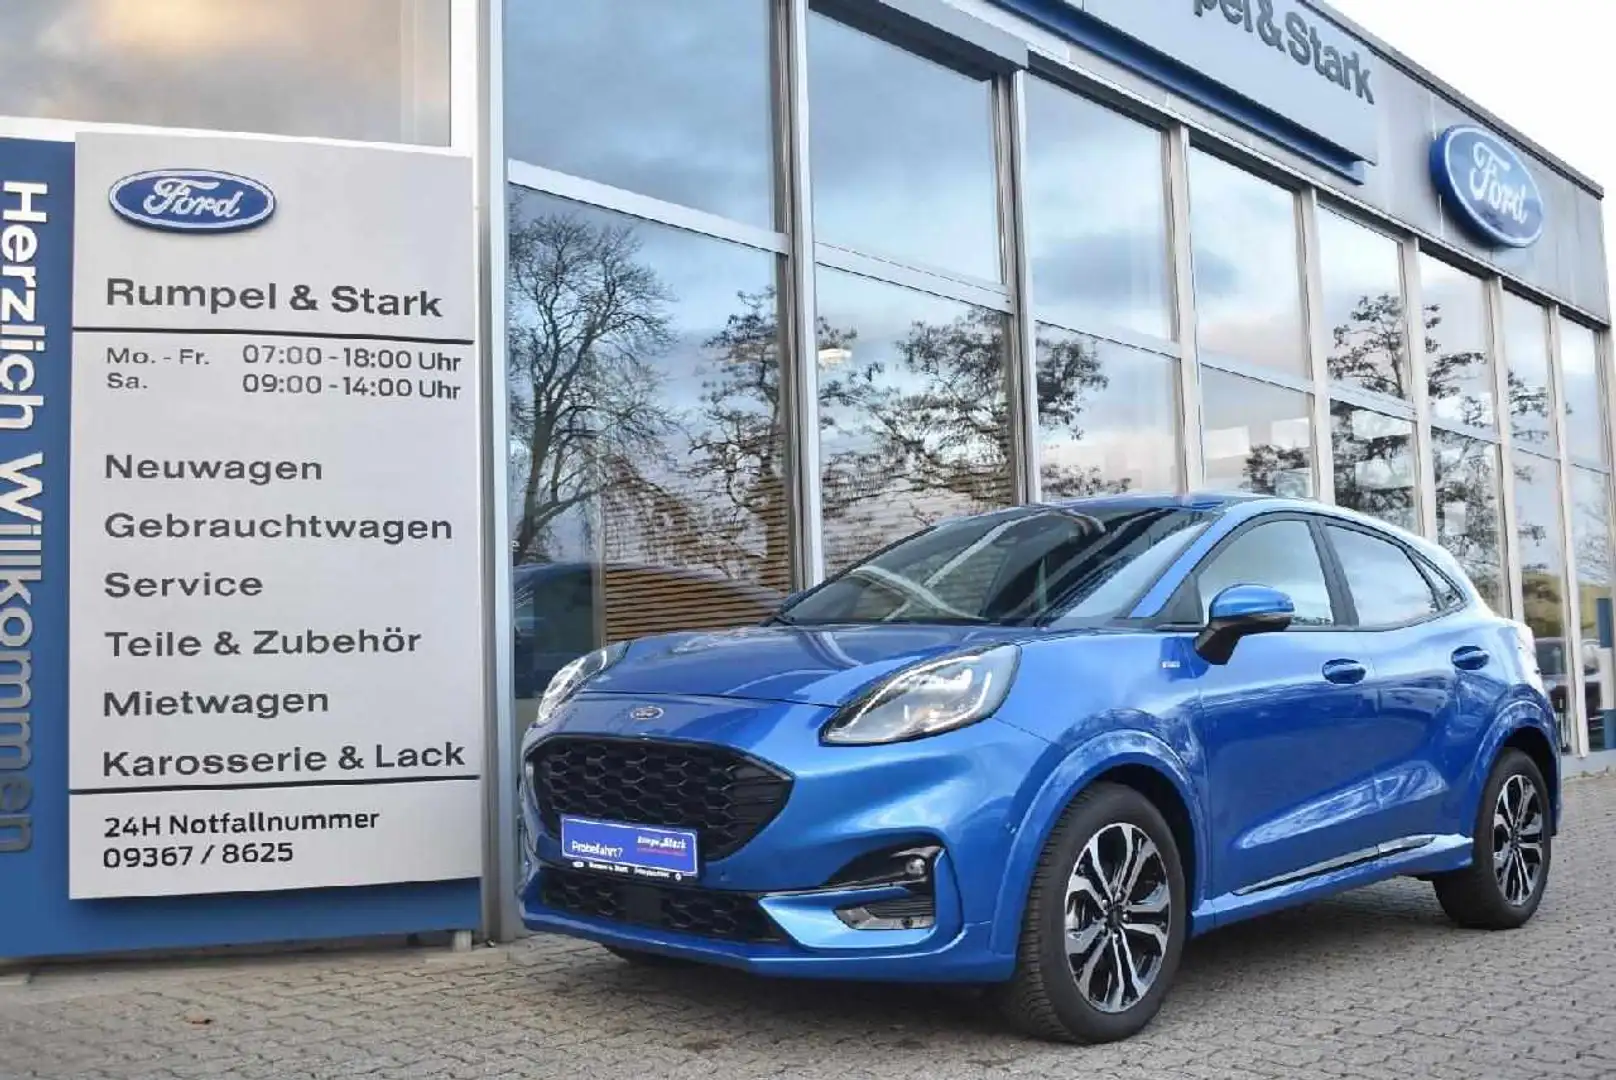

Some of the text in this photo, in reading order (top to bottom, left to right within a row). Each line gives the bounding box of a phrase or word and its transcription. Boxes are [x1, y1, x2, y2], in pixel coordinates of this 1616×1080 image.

[143, 177, 243, 218] Ford
[1469, 141, 1529, 224] Ford
[106, 277, 444, 318] Rumpel & Stark
[106, 347, 156, 364] Mo.
[179, 348, 210, 365] Fr.
[418, 351, 462, 372] Uhr
[107, 371, 148, 390] Sa.
[418, 379, 462, 400] Uhr
[105, 454, 322, 486] Neuwagen
[0, 181, 48, 852] Herzlich Willkommen
[105, 513, 452, 545] Gebrauchtwagen
[104, 572, 264, 598] Service
[105, 627, 422, 657] Teile & Zubehör
[103, 691, 329, 719] Mietwagen
[103, 742, 466, 777] Karosserie & Lack
[104, 811, 381, 838] 24H Notfallnummer
[103, 842, 294, 869] 09367 / 8625
